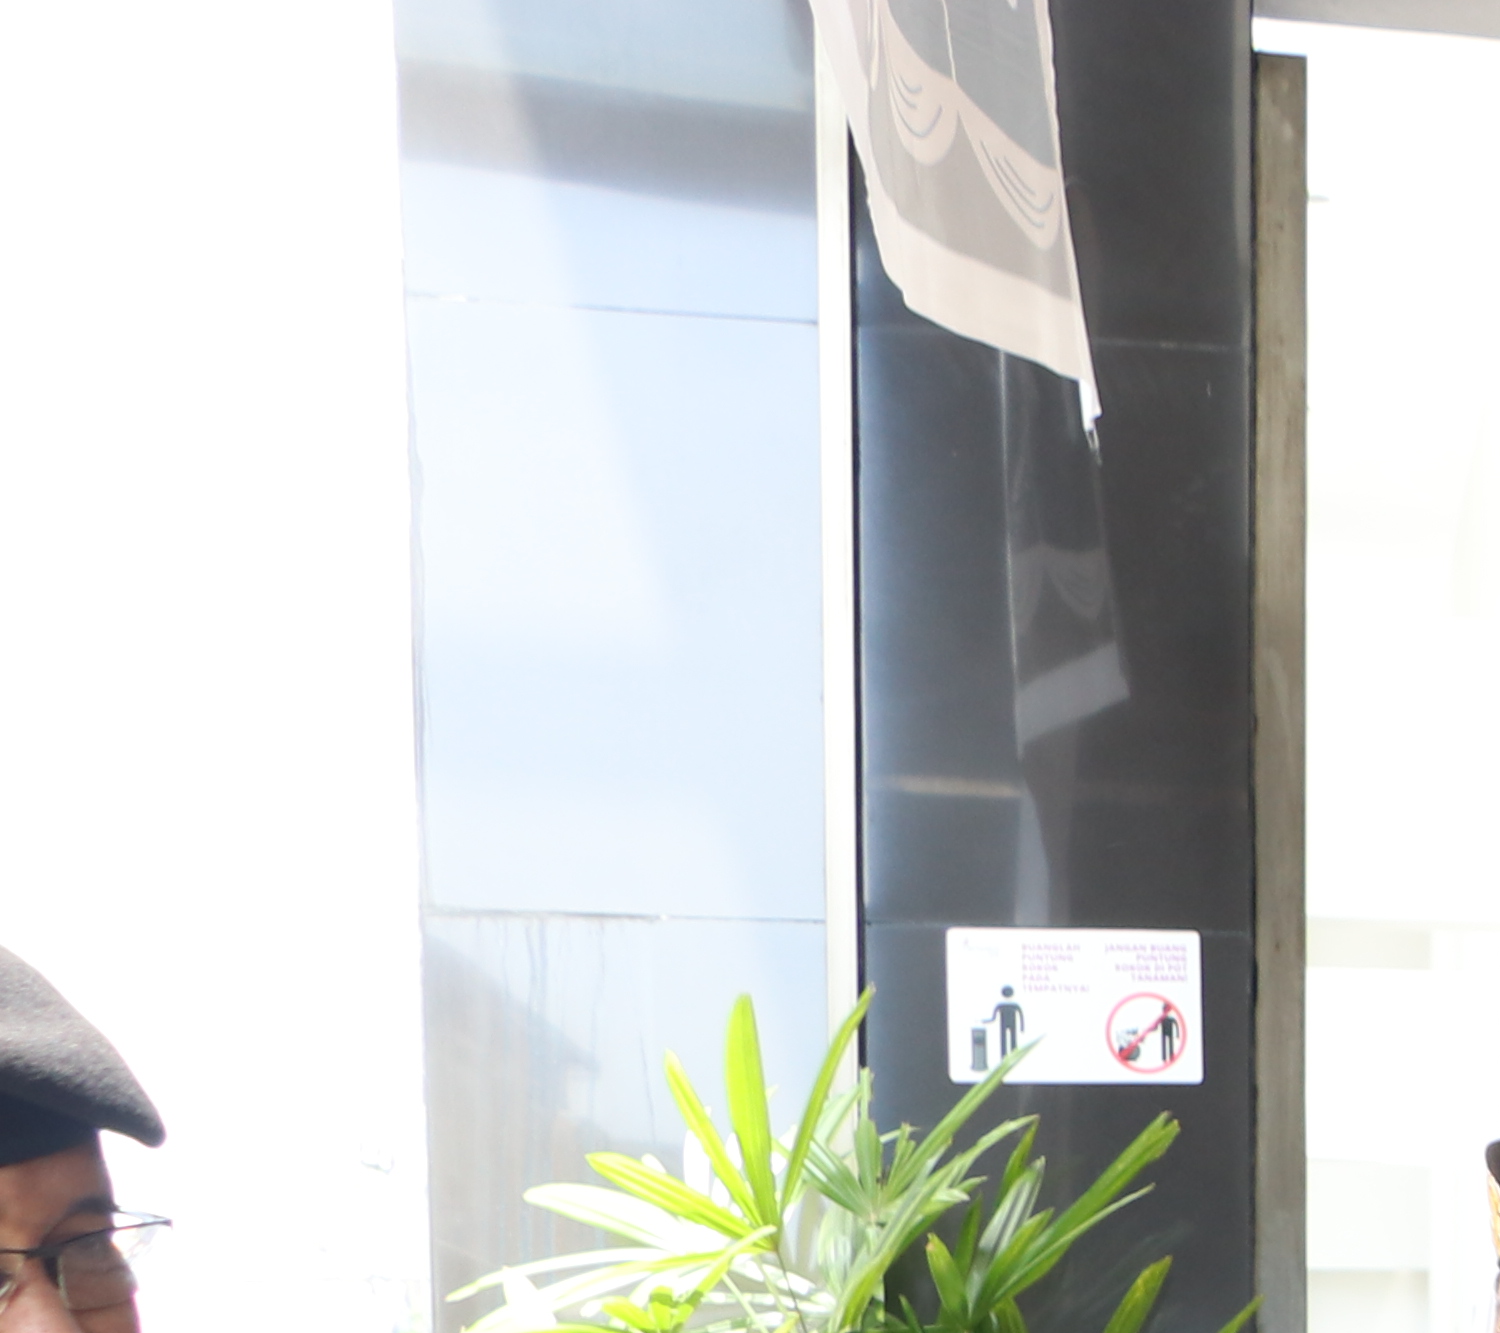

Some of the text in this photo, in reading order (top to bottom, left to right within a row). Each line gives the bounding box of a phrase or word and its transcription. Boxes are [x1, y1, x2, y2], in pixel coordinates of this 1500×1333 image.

[1105, 943, 1187, 953] JANGAN BUANG
[1021, 953, 1074, 962] PUNTUNG
[1135, 953, 1187, 963] PUNTUNG
[1021, 974, 1051, 982] PADA
